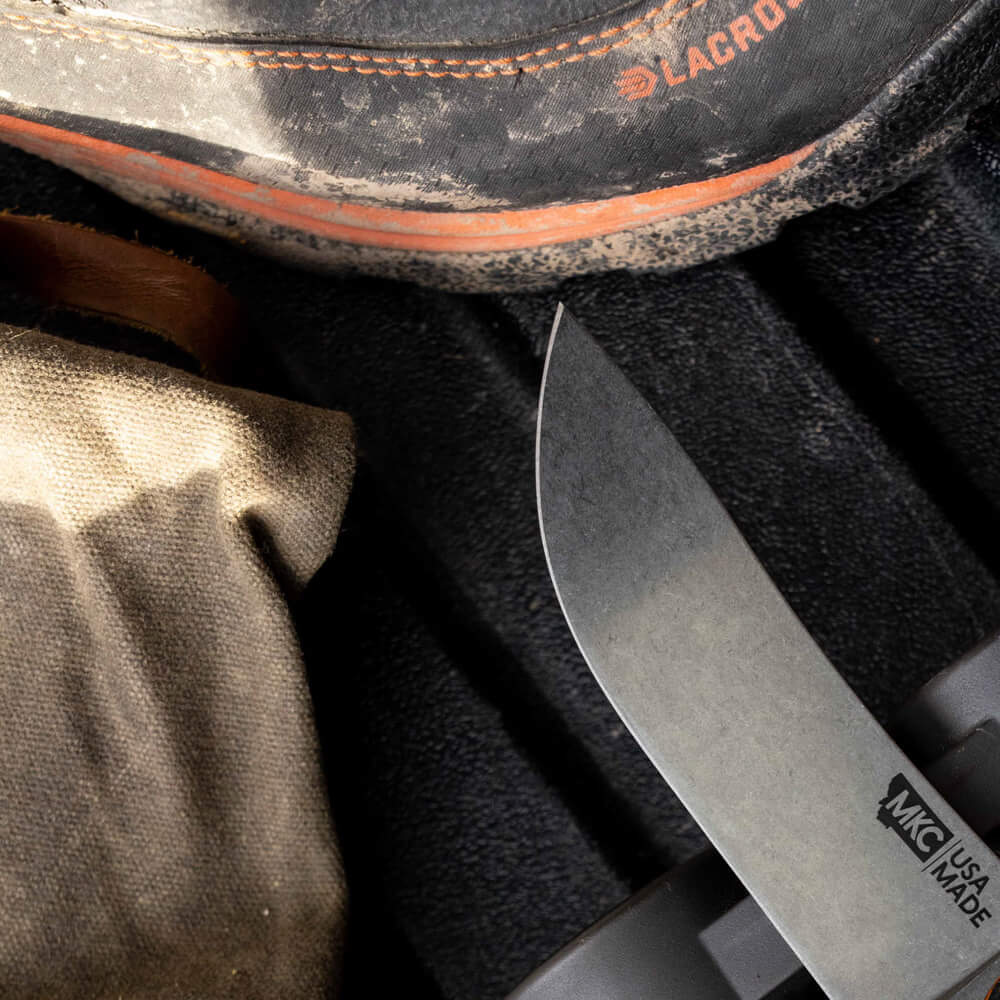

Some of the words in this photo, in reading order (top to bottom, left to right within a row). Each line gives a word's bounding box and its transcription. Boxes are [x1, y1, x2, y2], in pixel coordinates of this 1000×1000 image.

[660, 0, 800, 87] LACRO
[885, 789, 945, 853] MKC
[930, 860, 993, 929] MADE
[950, 847, 990, 896] USA
